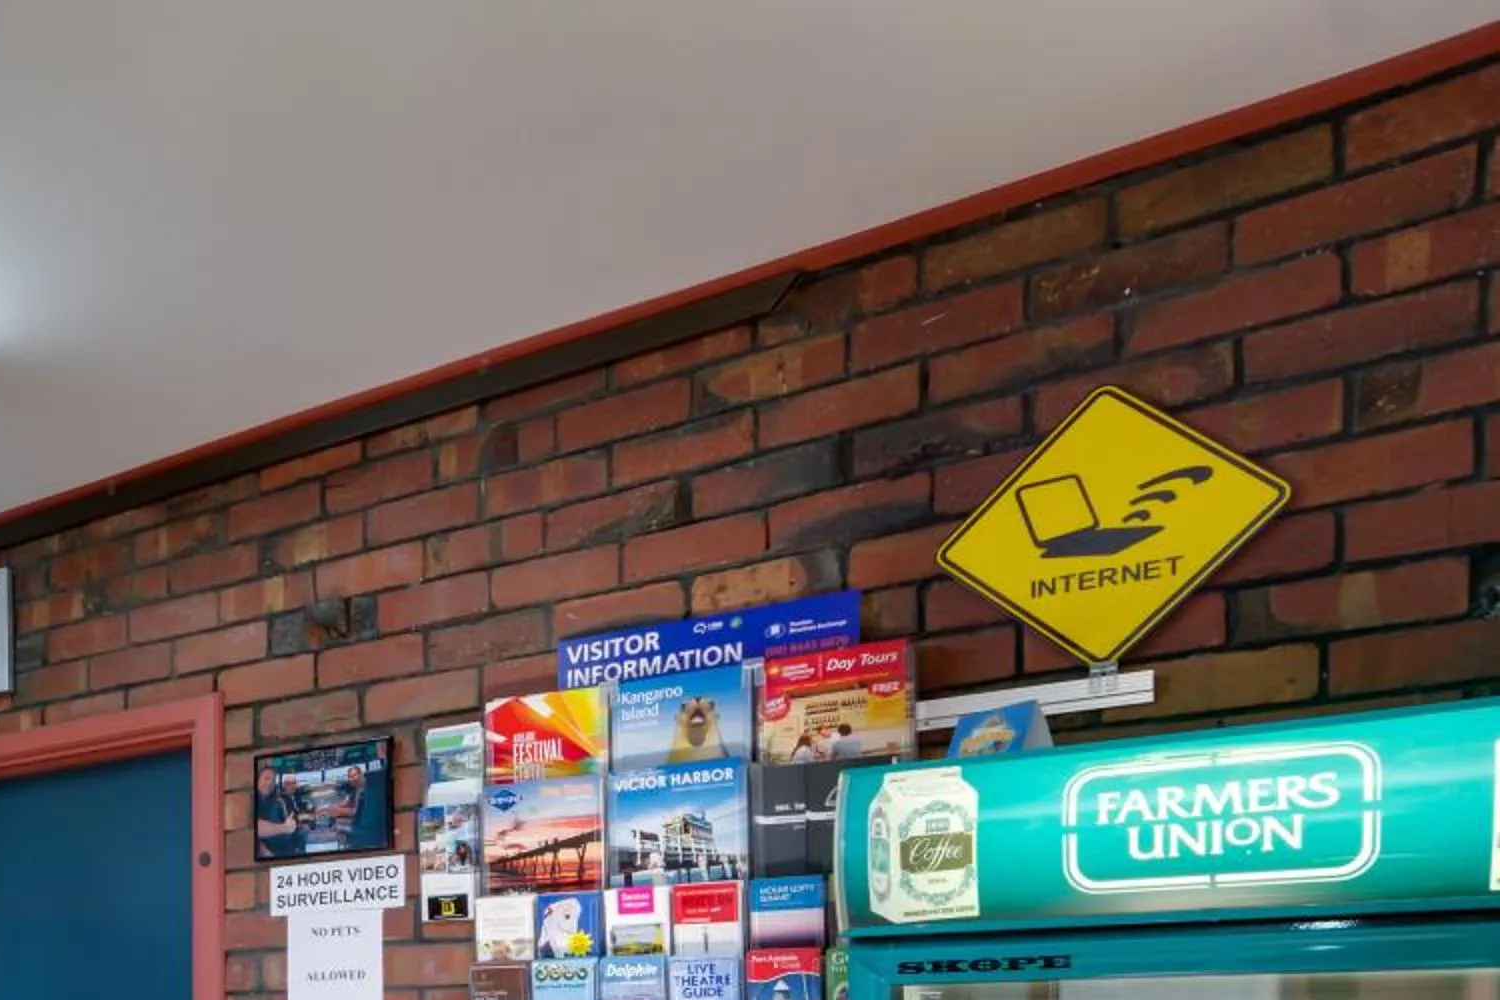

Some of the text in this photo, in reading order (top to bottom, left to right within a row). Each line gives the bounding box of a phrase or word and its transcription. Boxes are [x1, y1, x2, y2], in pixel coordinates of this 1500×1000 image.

[1030, 556, 1186, 600] INTERNET
[566, 632, 661, 665] VISITOR
[566, 642, 744, 689] INFORMATION
[826, 651, 898, 671] Day Tours
[621, 686, 683, 706] Kangaroo
[871, 681, 900, 694] FREE
[621, 705, 660, 722] Island
[513, 737, 565, 764] FESTIVAL
[614, 767, 735, 793] VICTOR HARBOR
[1096, 771, 1341, 825] FARMERS
[1128, 813, 1306, 861] UNION
[909, 836, 964, 873] Coffee
[277, 863, 399, 889] 24 HOUR VIDEO
[276, 884, 399, 909] SURVEILLANCE
[310, 925, 361, 937] NO PETS
[604, 962, 660, 980] Dolphin
[686, 963, 717, 976] LIVE
[897, 954, 1072, 975] SKOPE
[307, 969, 367, 982] ALLOWED
[674, 974, 731, 987] THEATRE
[682, 986, 725, 999] GUIDE
